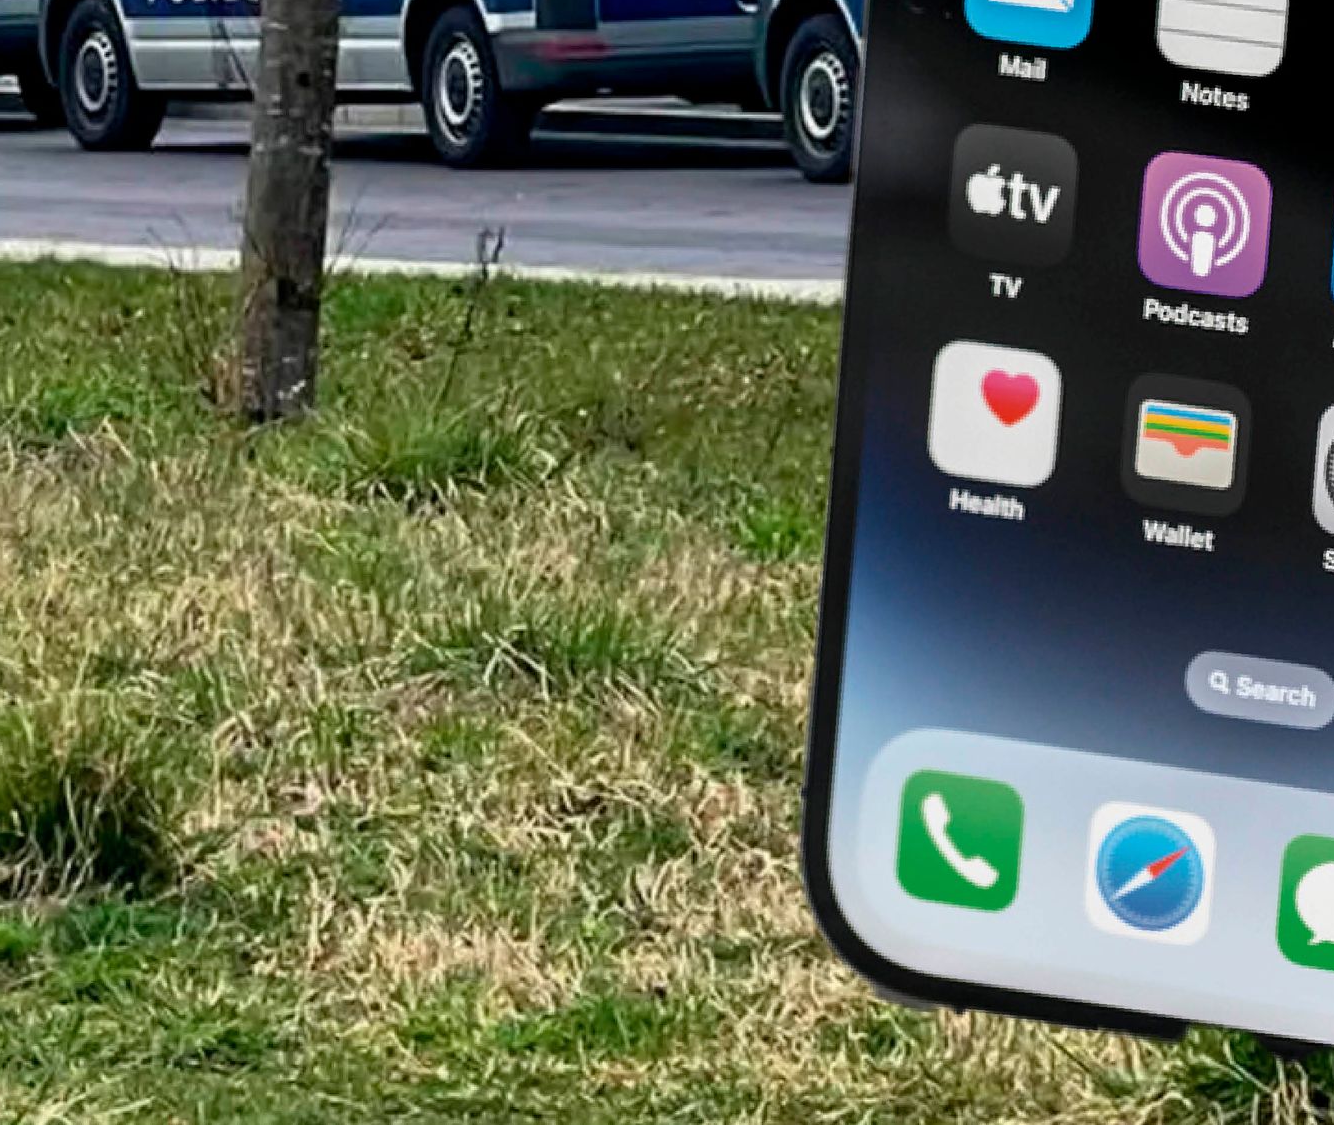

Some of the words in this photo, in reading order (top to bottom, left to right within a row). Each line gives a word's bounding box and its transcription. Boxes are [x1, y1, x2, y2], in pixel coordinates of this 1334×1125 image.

[998, 52, 1048, 81] Mail
[1180, 80, 1250, 111] Notes
[989, 273, 1023, 298] TV
[1142, 298, 1249, 334] Podcasts
[948, 488, 1025, 520] Health
[1142, 519, 1215, 552] Wallet
[1236, 672, 1317, 709] Search
